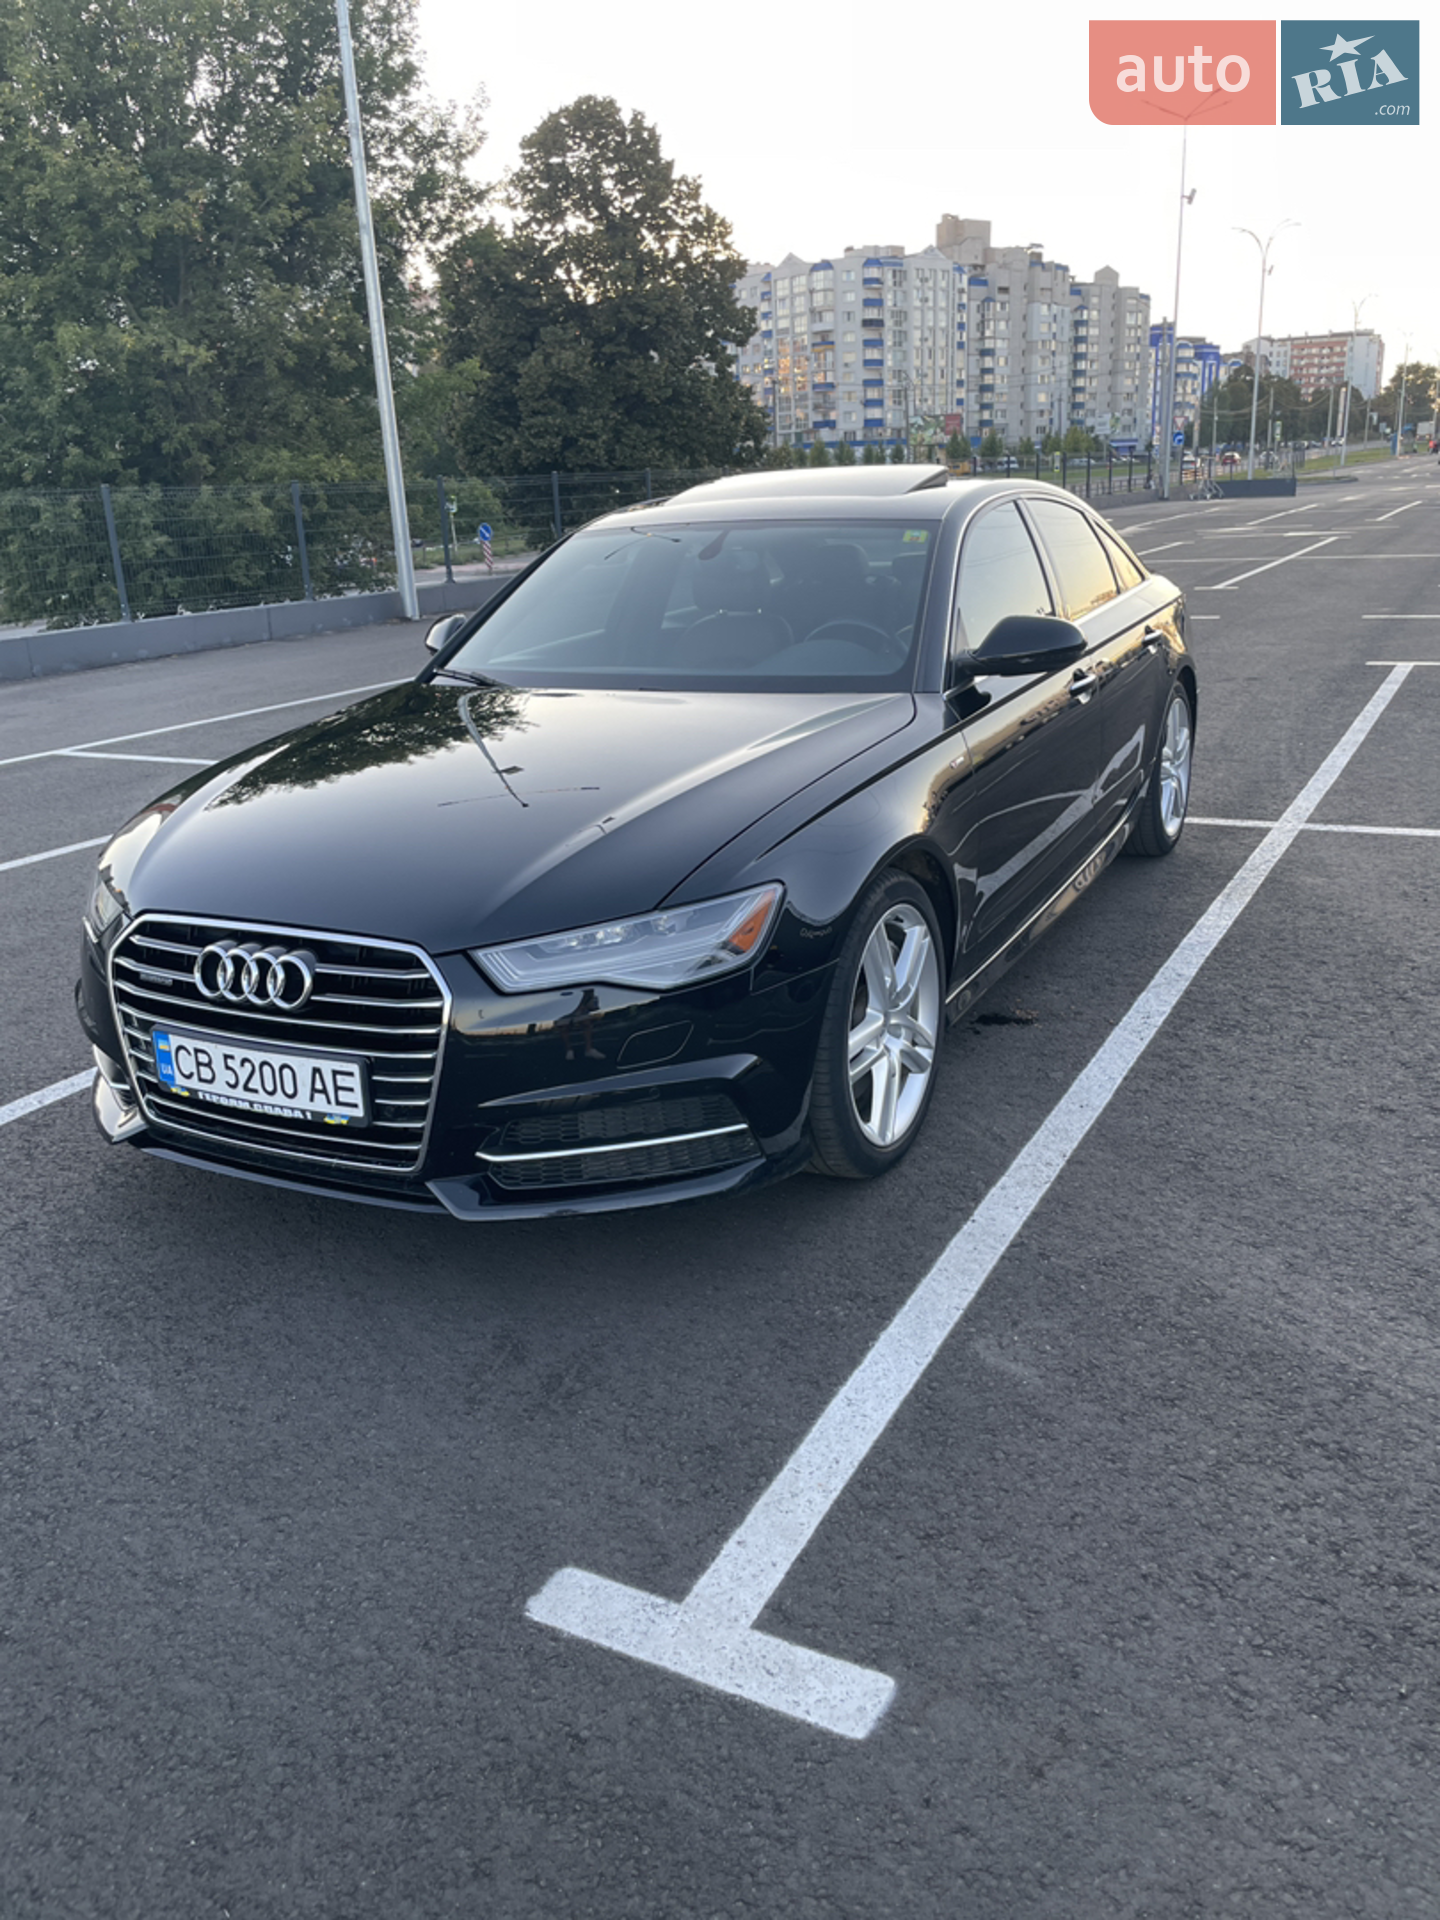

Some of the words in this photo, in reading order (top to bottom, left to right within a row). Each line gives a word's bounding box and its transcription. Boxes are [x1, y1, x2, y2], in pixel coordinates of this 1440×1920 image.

[174, 1045, 216, 1083] CB
[224, 1055, 298, 1099] 5200
[309, 1067, 359, 1108] AE
